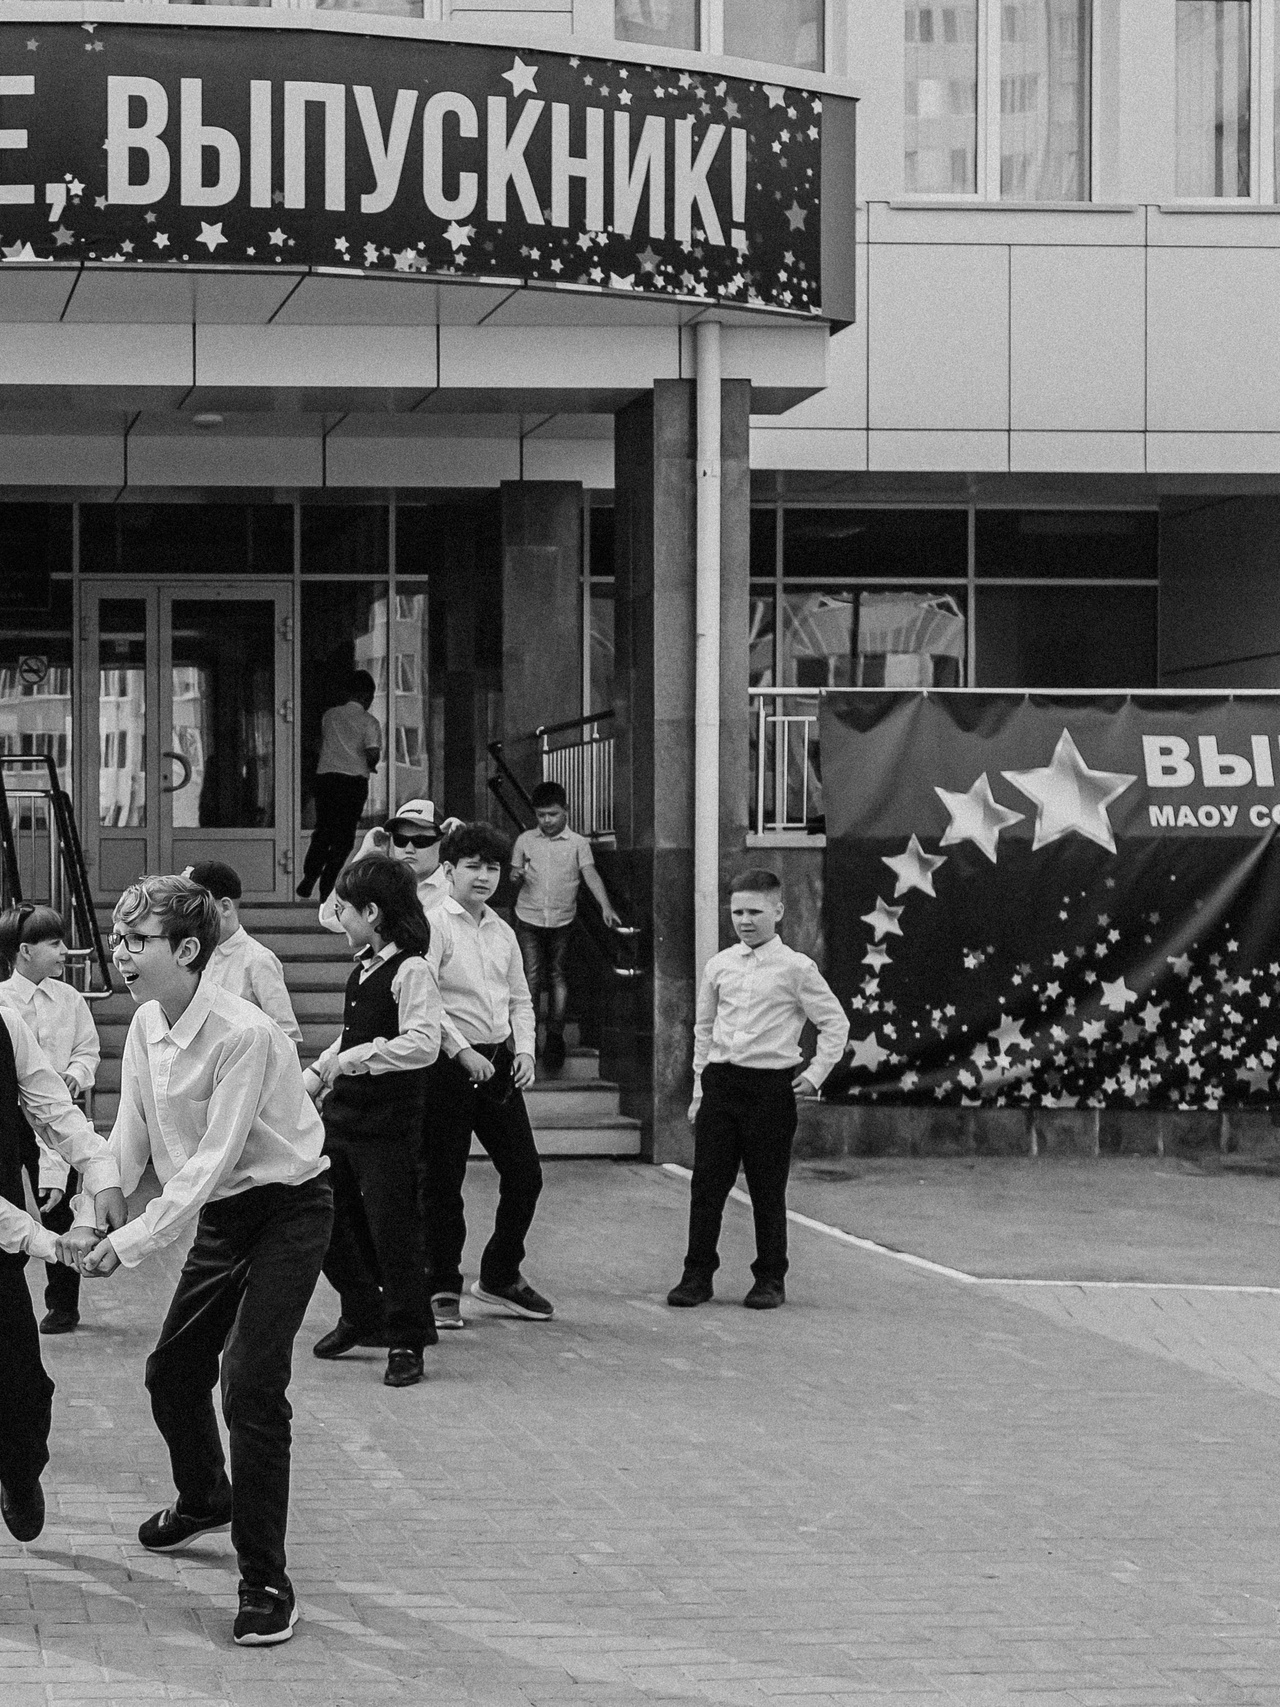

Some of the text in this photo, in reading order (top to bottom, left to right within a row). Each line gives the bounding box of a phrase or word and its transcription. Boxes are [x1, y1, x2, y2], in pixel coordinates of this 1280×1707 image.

[106, 75, 748, 252] ВЫПУСКНИК!
[1142, 734, 1280, 788] ВЫ
[1148, 804, 1239, 828] МАОУ
